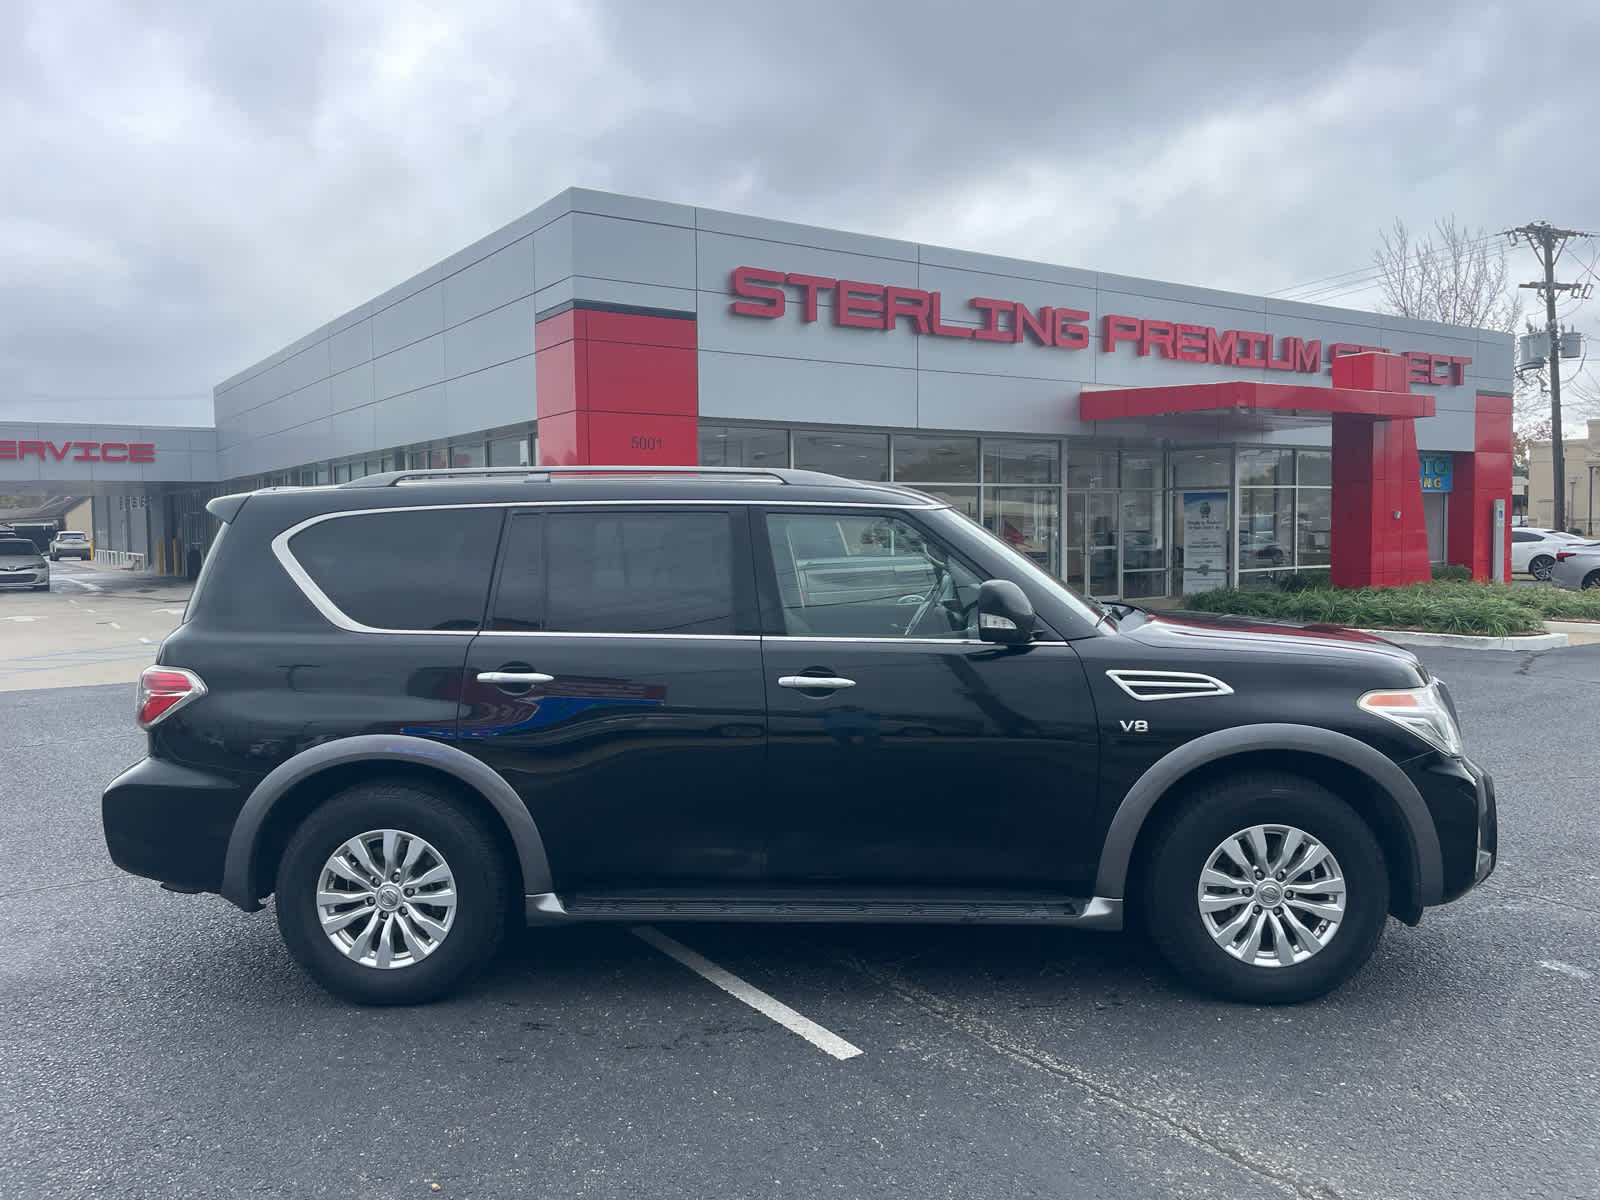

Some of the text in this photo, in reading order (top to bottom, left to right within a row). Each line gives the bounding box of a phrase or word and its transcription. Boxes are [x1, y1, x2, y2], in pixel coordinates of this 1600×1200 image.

[731, 266, 1473, 386] STERLING PREMIUM ECT
[632, 435, 663, 451] 5001
[1119, 719, 1149, 732] V8
